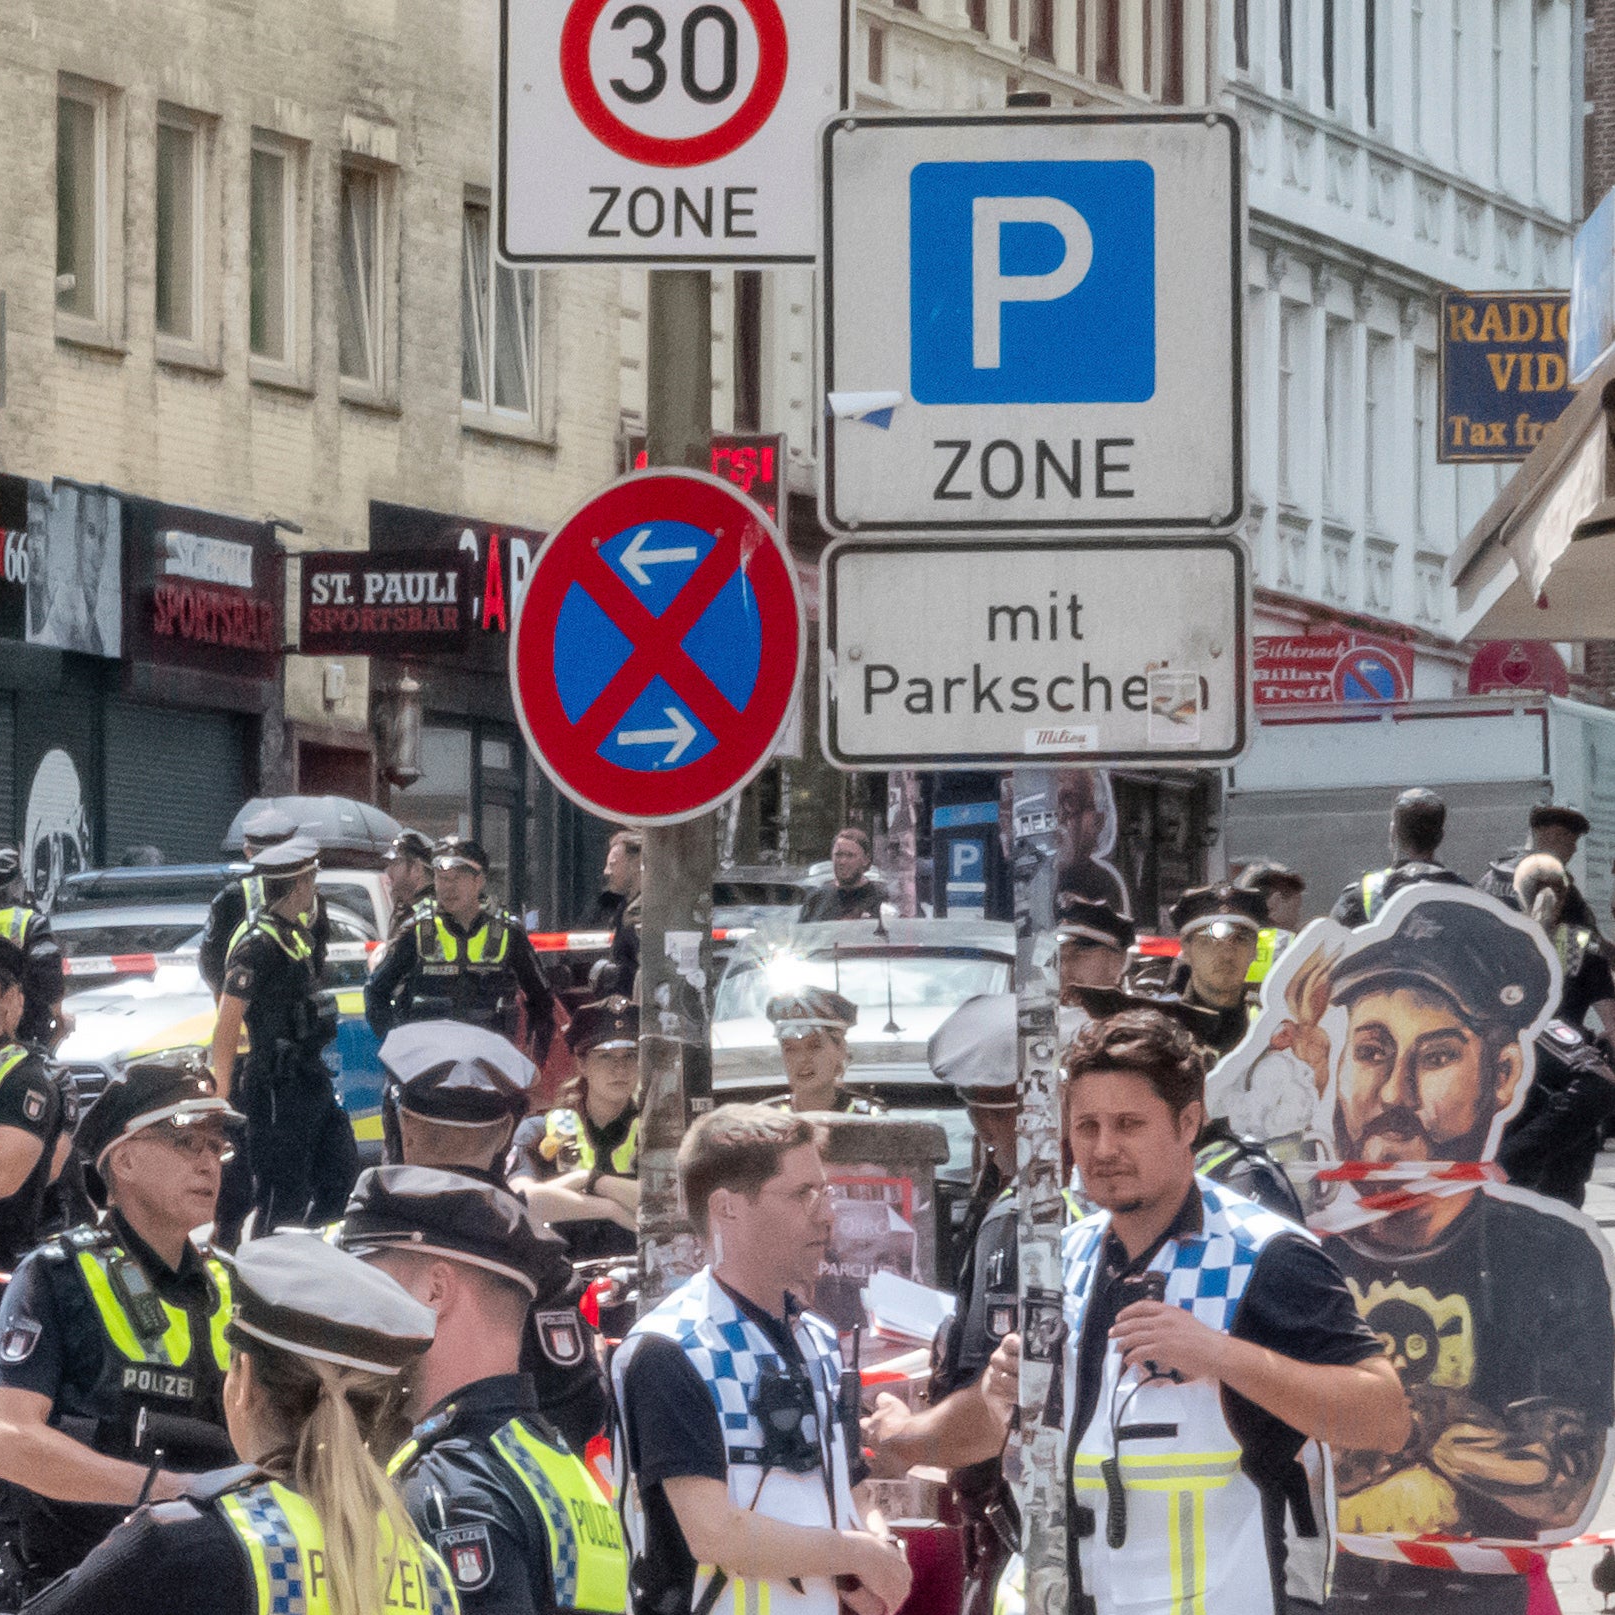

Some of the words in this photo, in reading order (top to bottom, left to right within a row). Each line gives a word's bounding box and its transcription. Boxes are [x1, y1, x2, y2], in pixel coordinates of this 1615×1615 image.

[610, 5, 737, 104] 30
[588, 187, 758, 238] ZONE
[972, 197, 1093, 369] P
[1486, 353, 1570, 392] VID
[1449, 415, 1508, 447] Tax
[933, 438, 1135, 499] ZONE
[311, 571, 354, 605] ST.
[364, 571, 459, 605] PAULI
[307, 606, 460, 633] SPORTSBAR
[987, 591, 1084, 641] mit
[863, 662, 1210, 715] Parksche
[952, 846, 978, 876] P
[123, 1368, 194, 1398] POLIZEI
[306, 1548, 426, 1611] PZEI
